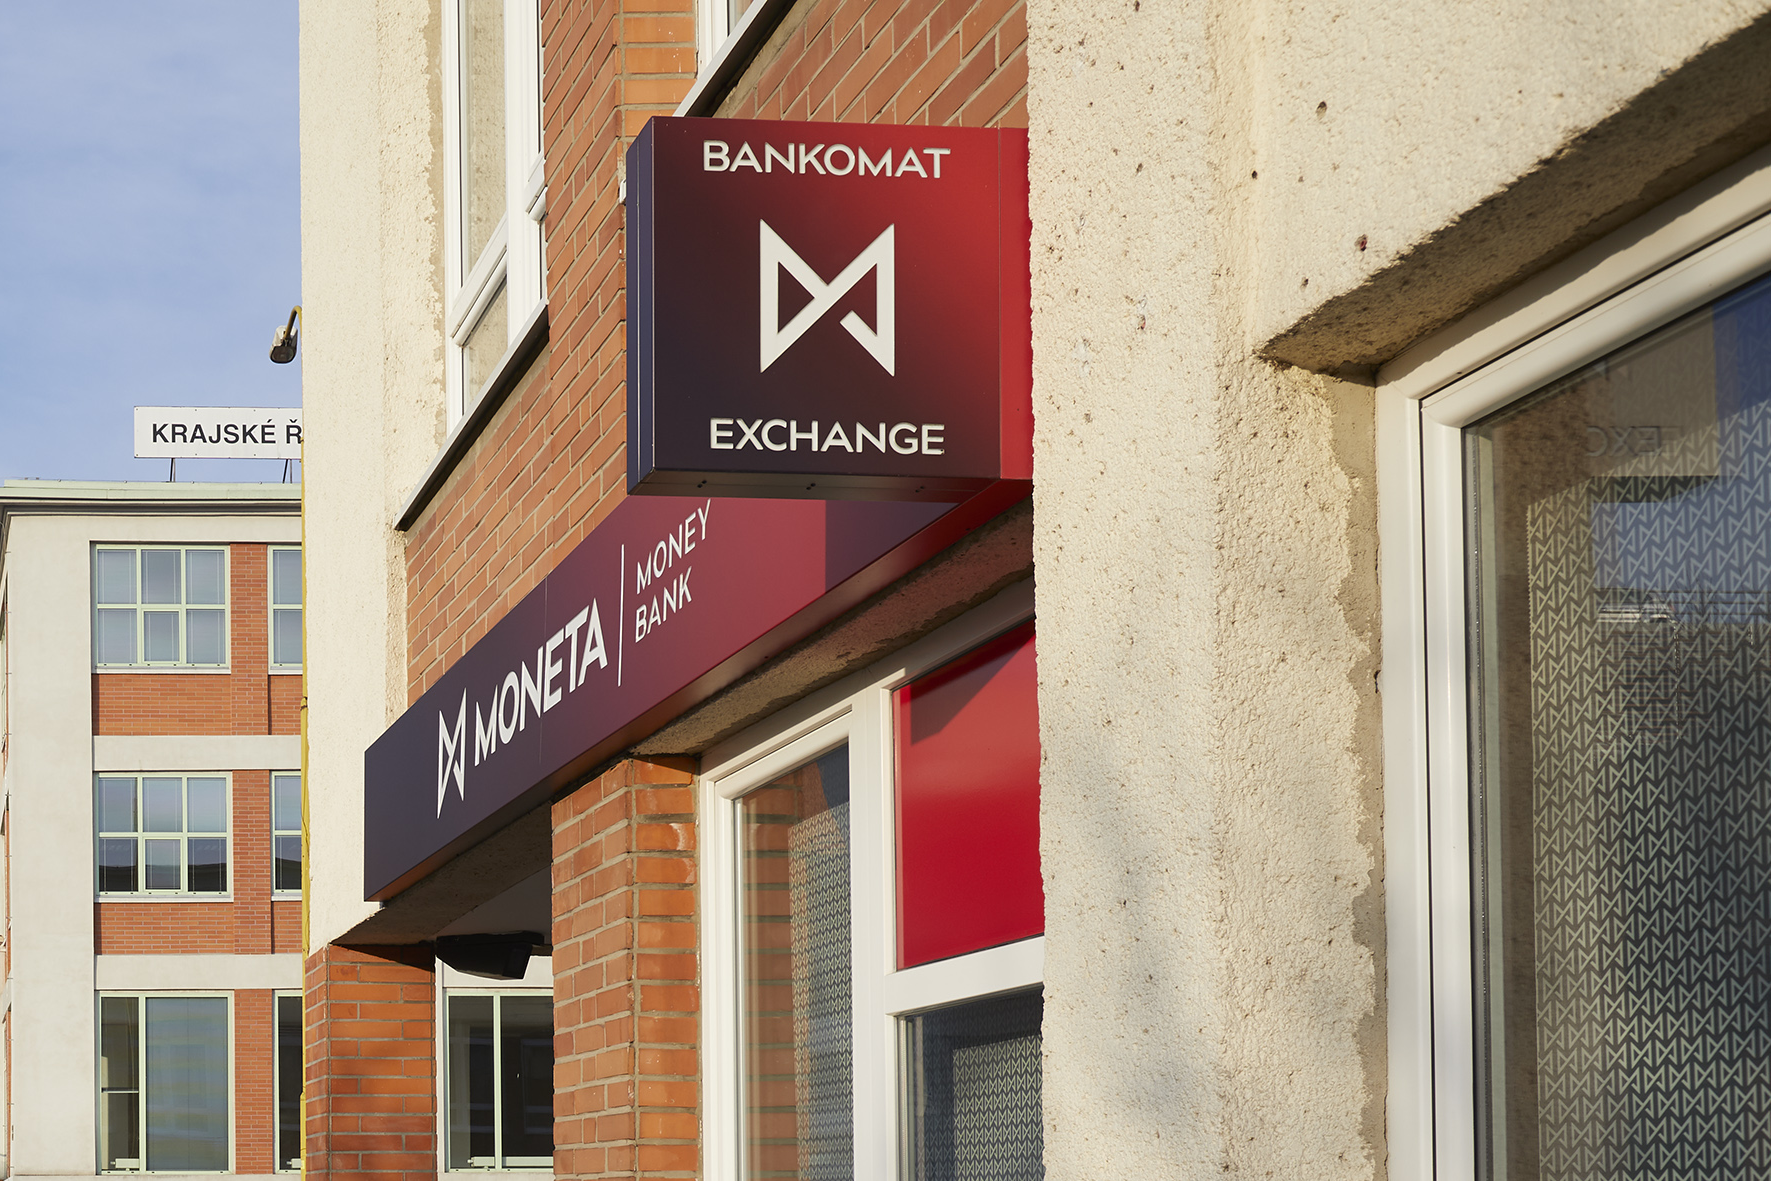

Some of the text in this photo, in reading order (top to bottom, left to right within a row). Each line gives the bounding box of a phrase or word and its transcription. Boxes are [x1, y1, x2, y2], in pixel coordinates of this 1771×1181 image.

[703, 140, 951, 179] BANKOMAT
[152, 419, 276, 444] KRAJSKÉ
[710, 417, 946, 455] EXCHANGE
[636, 499, 712, 596] MONEY
[635, 566, 692, 643] BANK
[474, 597, 609, 767] MONETA
